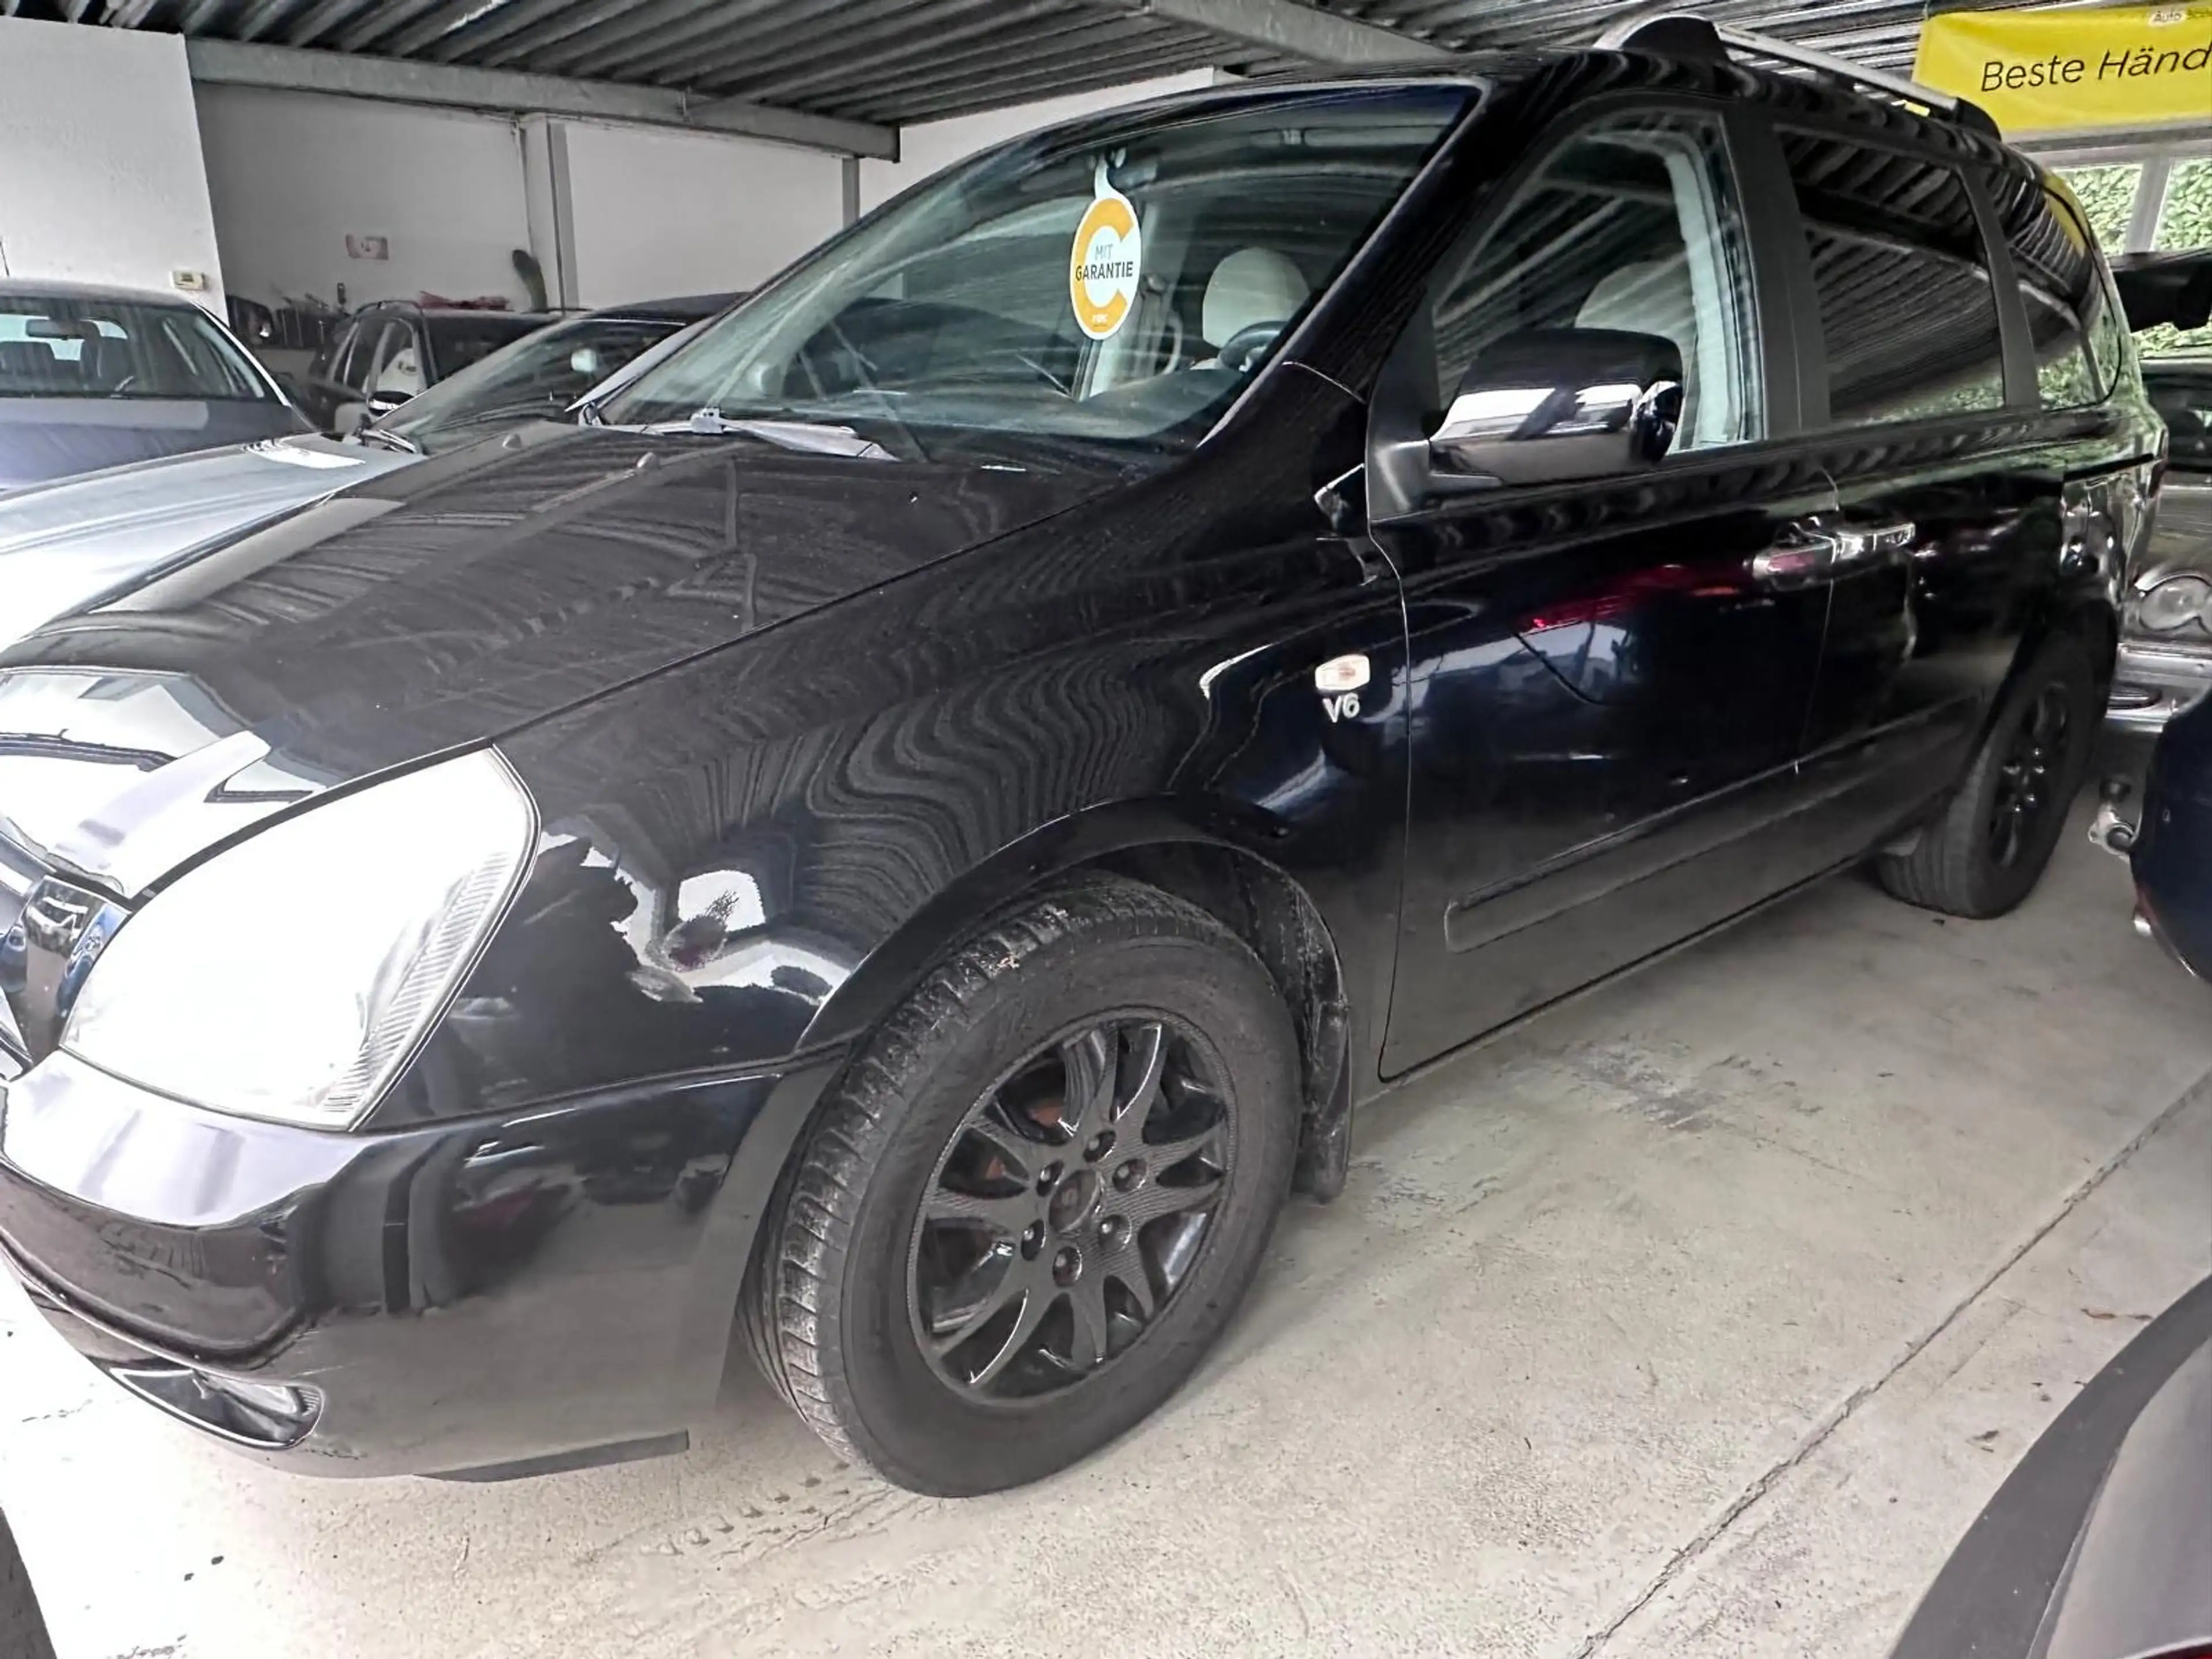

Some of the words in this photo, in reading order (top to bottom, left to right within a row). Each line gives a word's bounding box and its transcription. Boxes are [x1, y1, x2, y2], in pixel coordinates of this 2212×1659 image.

[1980, 55, 2085, 92] Beste
[2097, 40, 2212, 80] Händ
[1094, 244, 1113, 260] MIT
[1075, 261, 1133, 281] GARANTIE
[1323, 692, 1360, 723] V6
